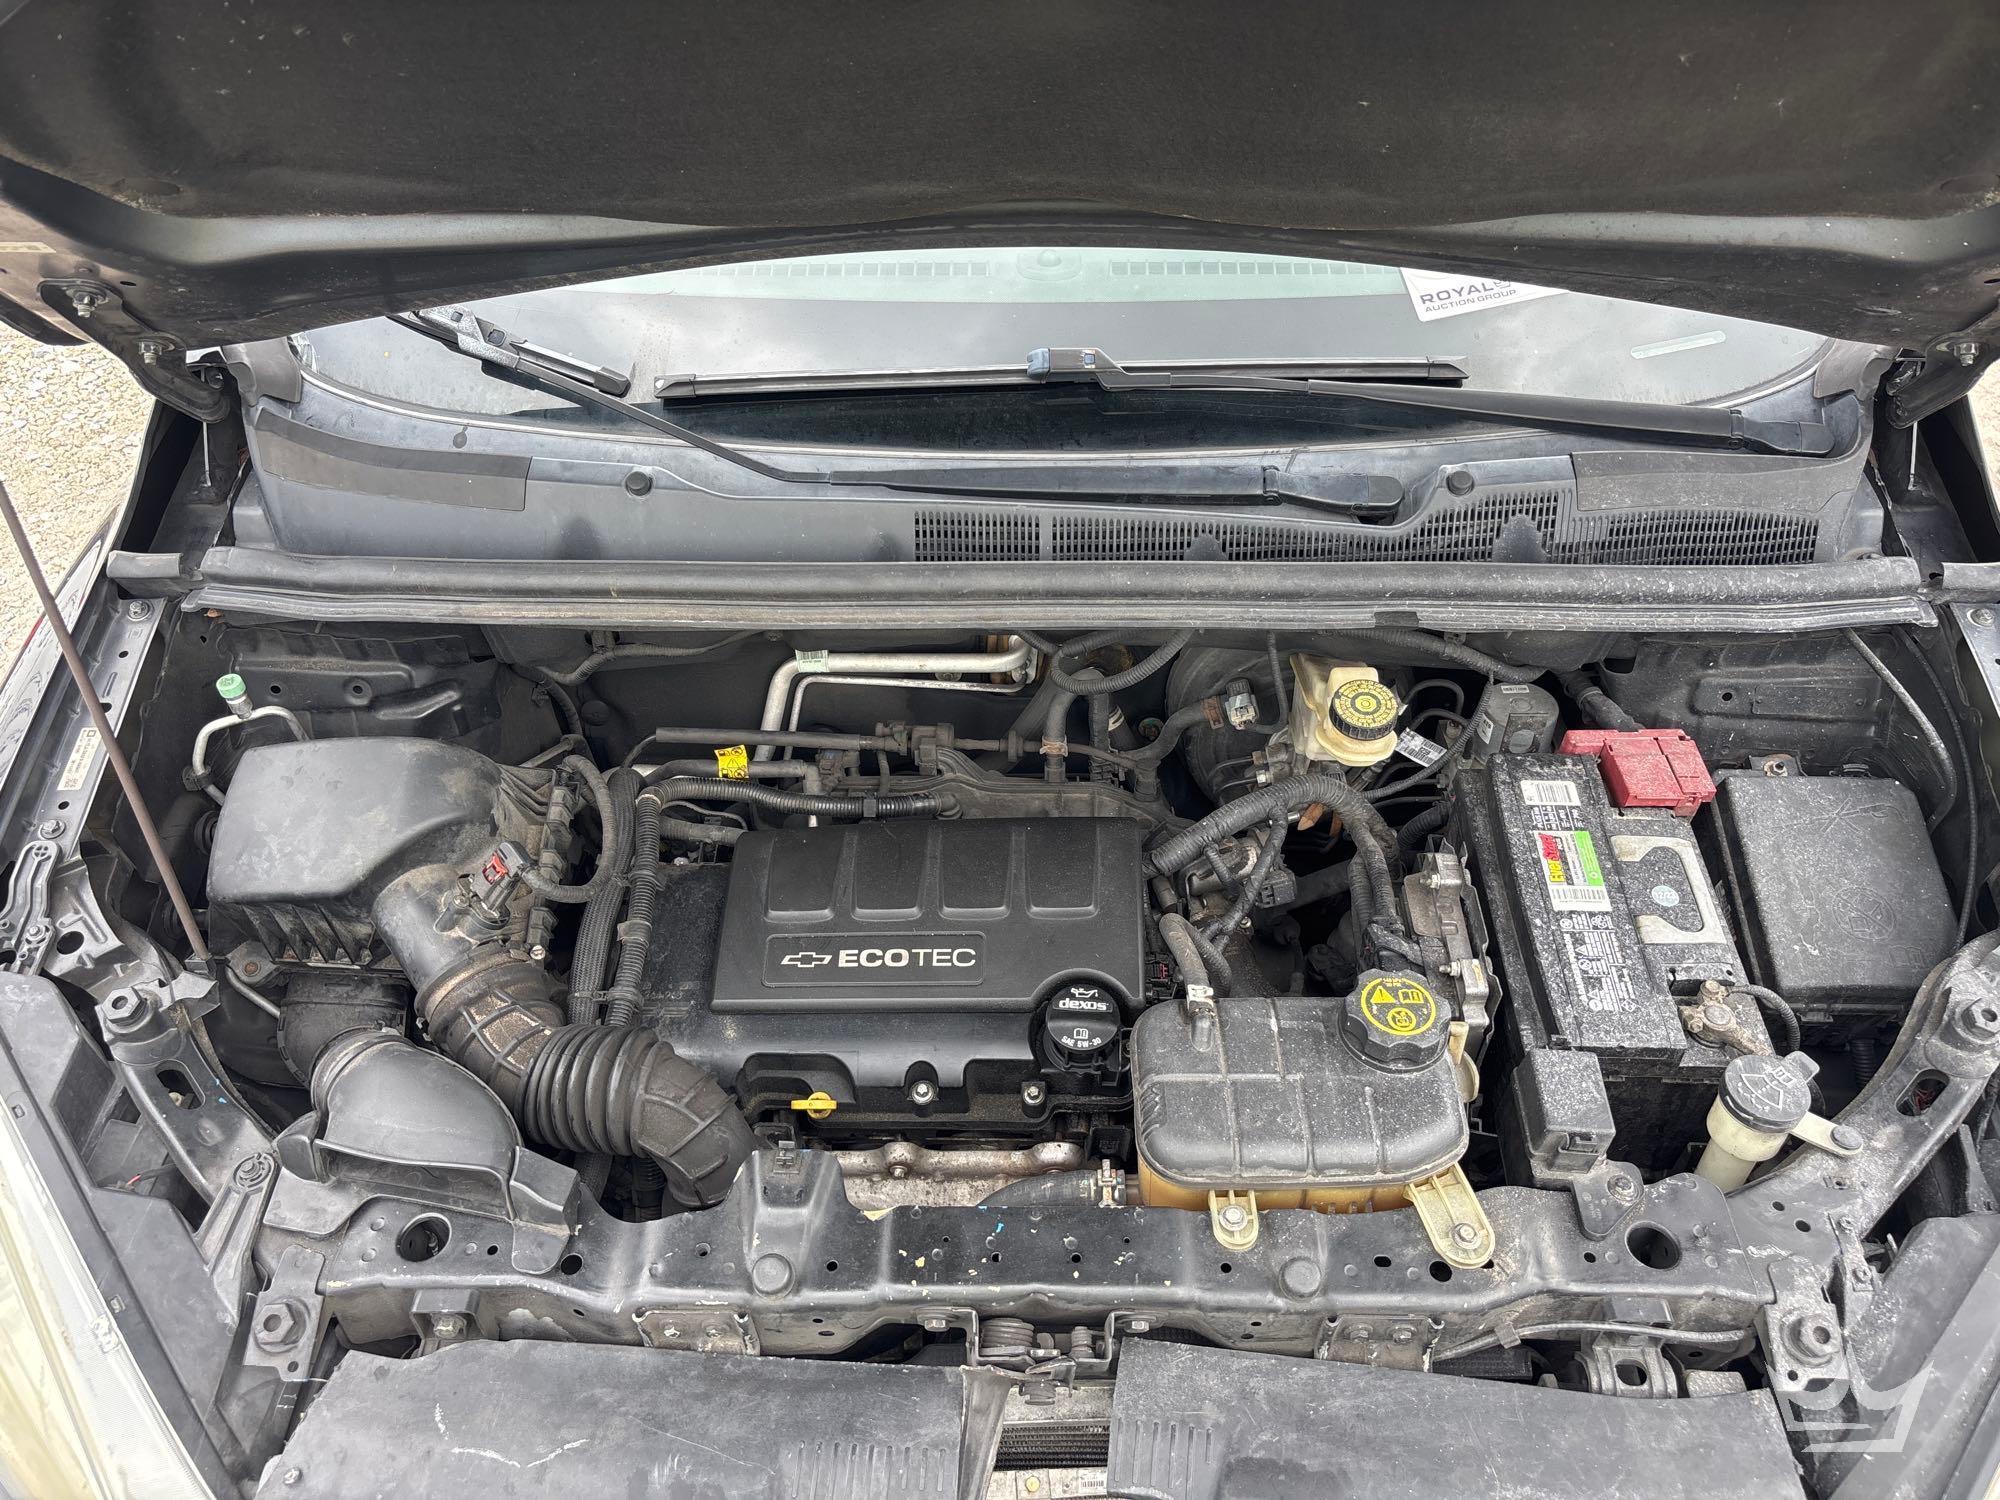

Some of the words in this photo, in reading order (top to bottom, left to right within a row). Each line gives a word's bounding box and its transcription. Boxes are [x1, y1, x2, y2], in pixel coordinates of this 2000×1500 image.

[1420, 282, 1494, 305] ROYAL
[1425, 297, 1476, 313] AUCTION
[1476, 289, 1517, 302] GROUP
[838, 948, 976, 968] ECOTEC
[1058, 997, 1107, 1011] dexos
[1061, 1035, 1076, 1047] SAE
[1077, 1036, 1102, 1048] 5W-30
